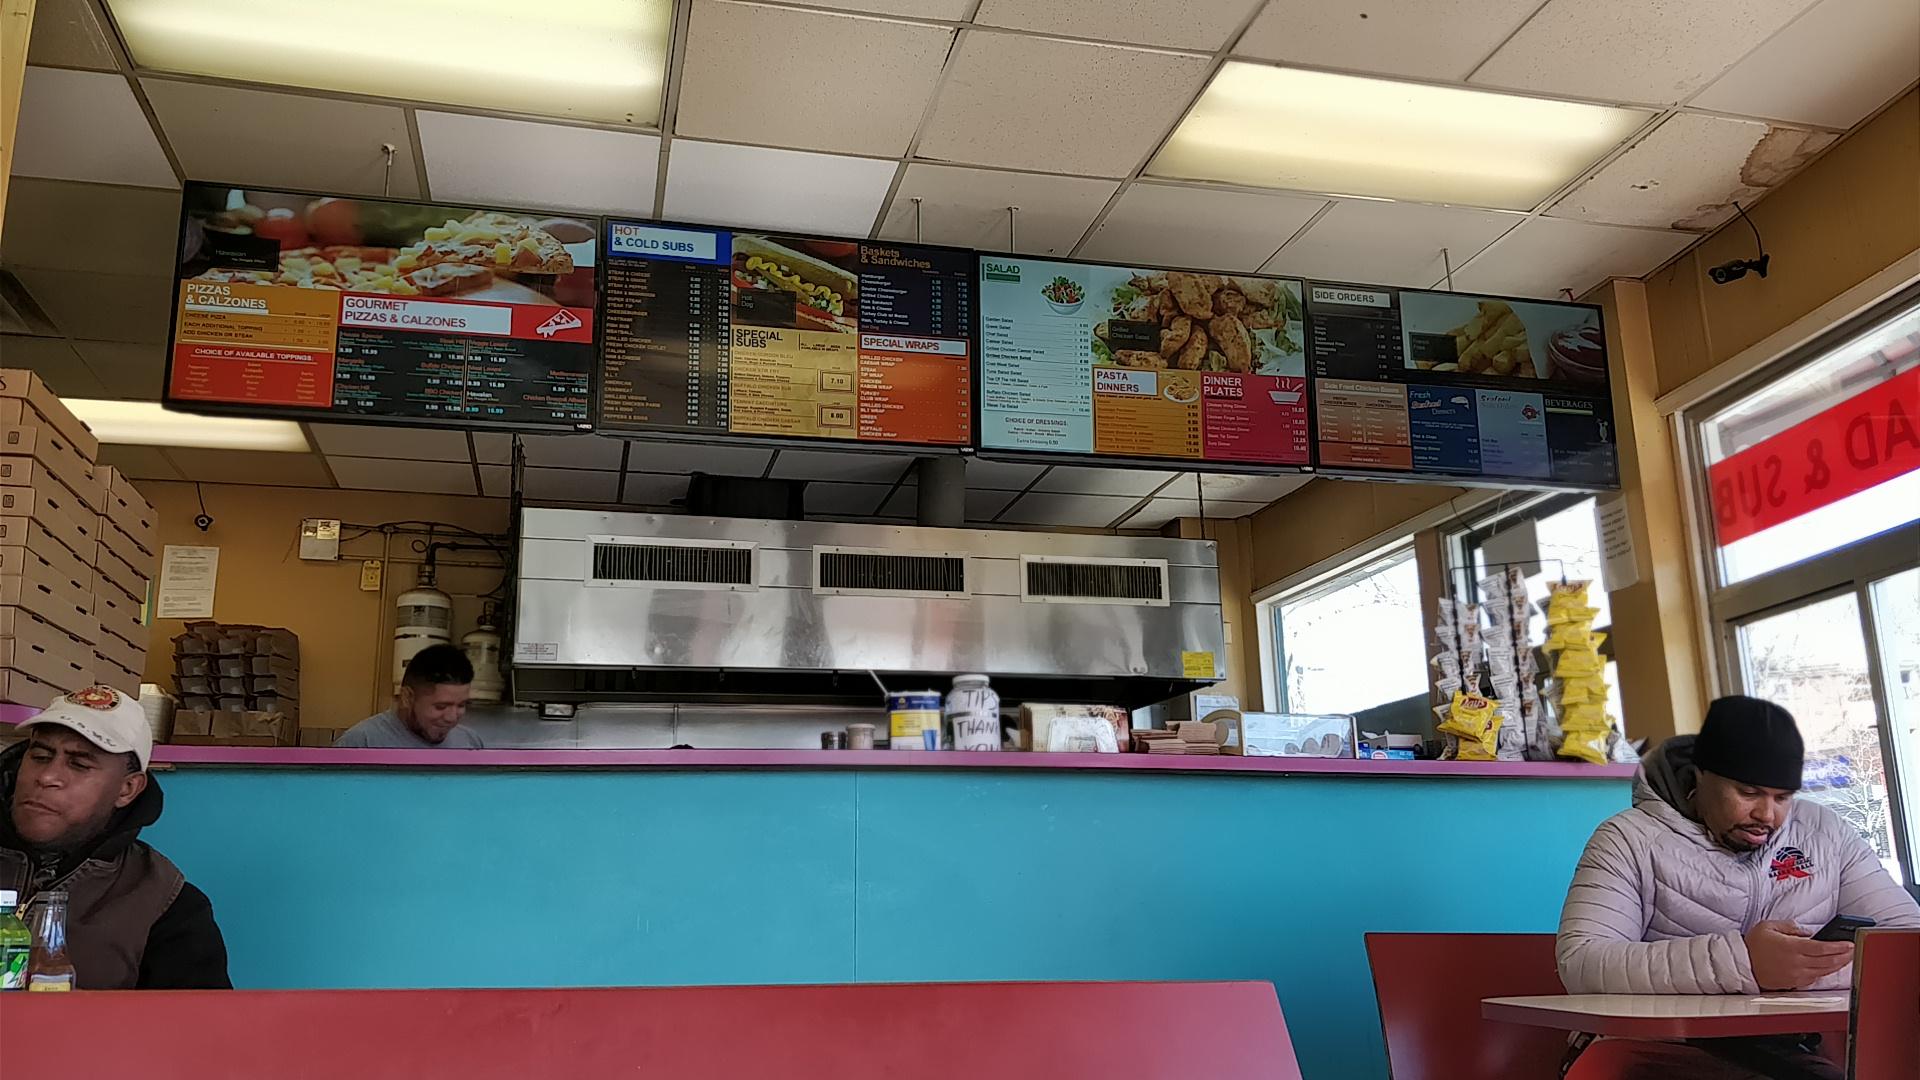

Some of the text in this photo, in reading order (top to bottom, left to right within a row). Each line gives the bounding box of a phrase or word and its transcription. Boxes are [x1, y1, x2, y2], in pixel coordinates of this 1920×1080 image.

[614, 226, 640, 236] HOT
[614, 236, 694, 252] & COLD SUBS
[860, 246, 900, 258] Baskets
[860, 256, 931, 269] & Sandwiches
[986, 263, 1020, 274] SALAD
[187, 284, 231, 295] PIZZAS
[186, 294, 266, 309] & CALZONES
[1314, 291, 1375, 303] SIDE ORDERS
[346, 298, 408, 311] GOURMET
[345, 310, 466, 328] PIZZAS & CALZONES
[201, 322, 236, 330] ADDITIONAL
[736, 328, 784, 341] SPECIAL
[736, 338, 767, 348] SUBS
[863, 337, 904, 348] SPECIAL
[904, 340, 940, 351] WRAPS
[194, 348, 222, 356] CHOICE
[236, 350, 274, 359] AVAILABLE
[1096, 371, 1128, 380] PASTA
[1203, 376, 1242, 386] DINNER
[1096, 382, 1140, 392] DINNERS
[1203, 386, 1243, 397] PLATES
[1544, 398, 1593, 409] BEVERAGES
[962, 690, 998, 711] TIPS
